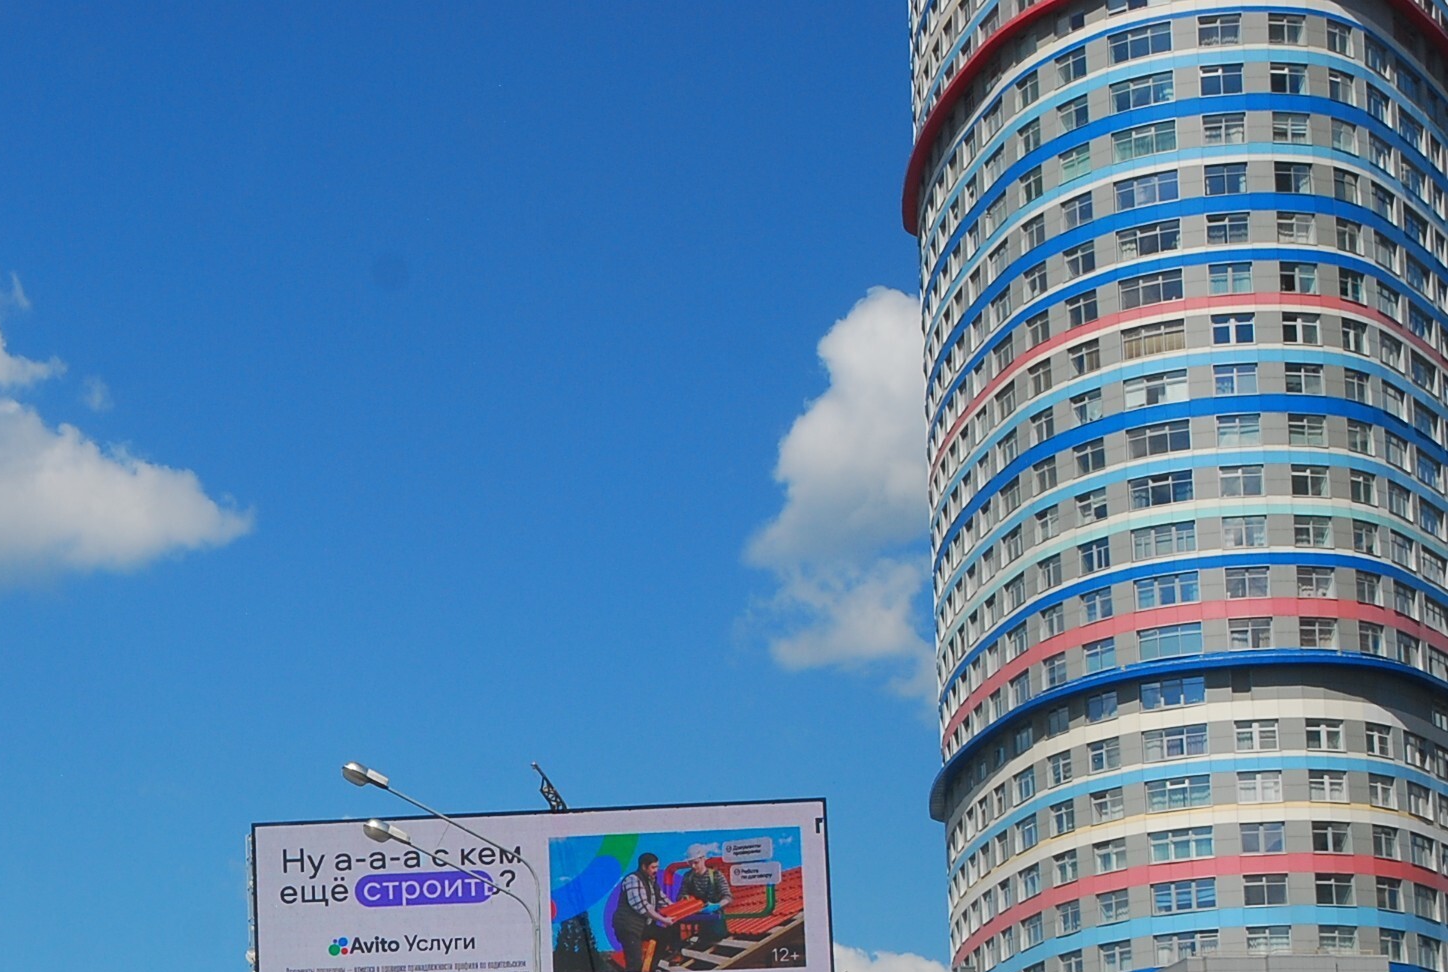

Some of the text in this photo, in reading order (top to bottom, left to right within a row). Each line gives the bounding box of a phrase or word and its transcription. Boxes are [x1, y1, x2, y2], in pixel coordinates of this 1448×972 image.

[282, 847, 326, 880] Ну
[334, 849, 421, 872] а-а-а
[460, 845, 522, 867] кем
[279, 876, 350, 907] ещё
[349, 934, 476, 955] Avito Услуги
[771, 947, 800, 962] 12+
